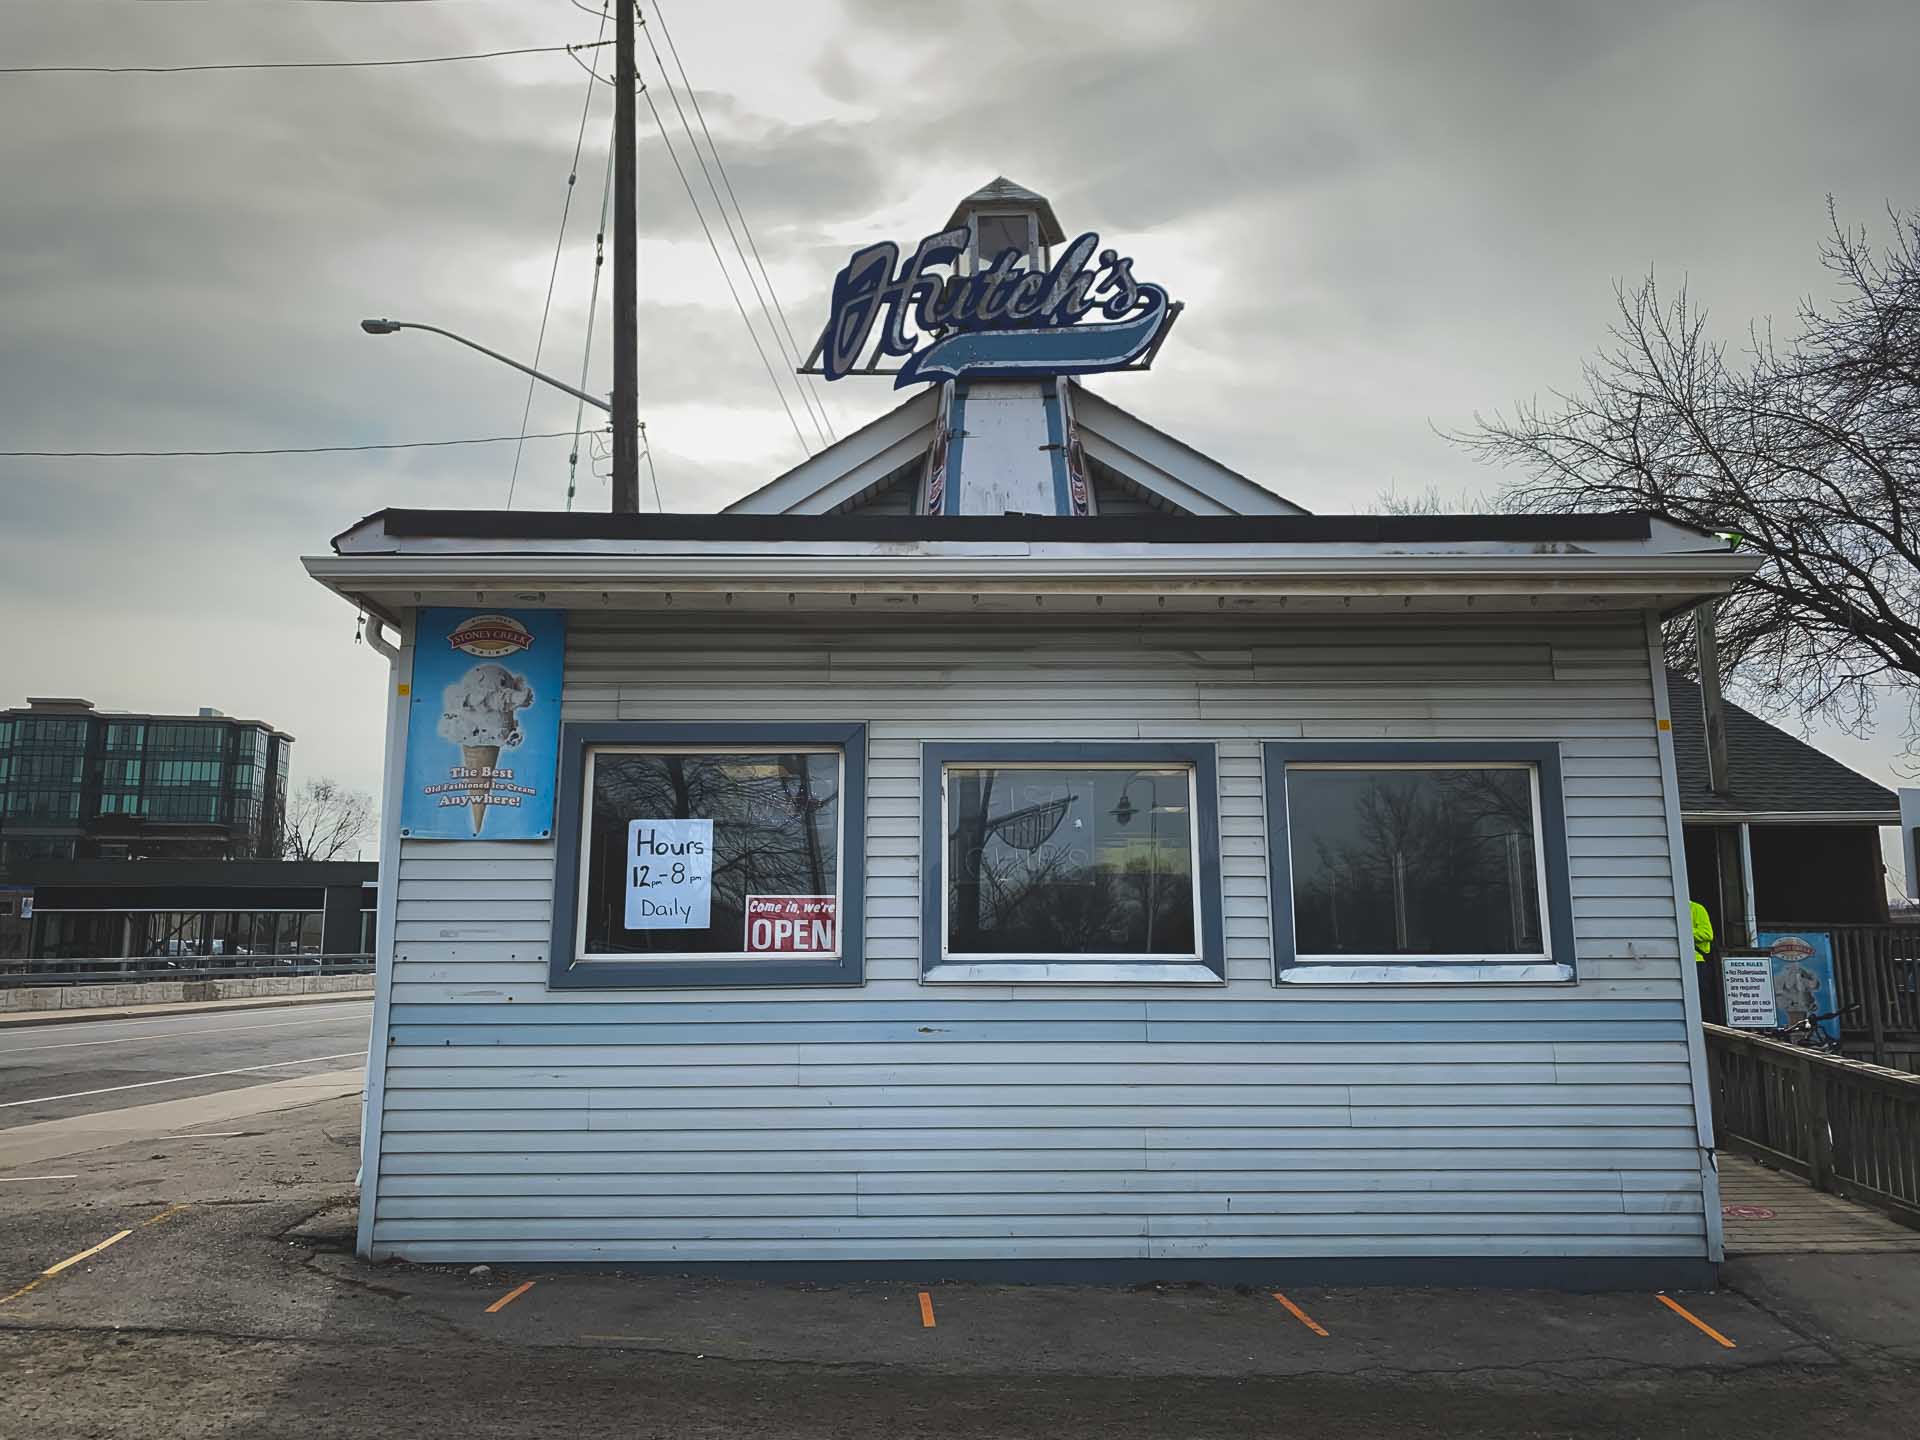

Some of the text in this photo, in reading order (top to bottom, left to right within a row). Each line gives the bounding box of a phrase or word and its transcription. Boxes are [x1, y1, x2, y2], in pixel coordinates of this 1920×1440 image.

[824, 227, 1145, 381] Hutch's
[453, 630, 526, 645] STONEY CREEK
[450, 766, 513, 779] The Best
[424, 779, 536, 795] Old Fashioned Ice Cream
[439, 794, 521, 807] Anywhere!
[637, 829, 704, 857] Hours
[641, 897, 692, 924] Daily
[750, 901, 835, 914] Come in, we're
[752, 919, 832, 950] OPEN
